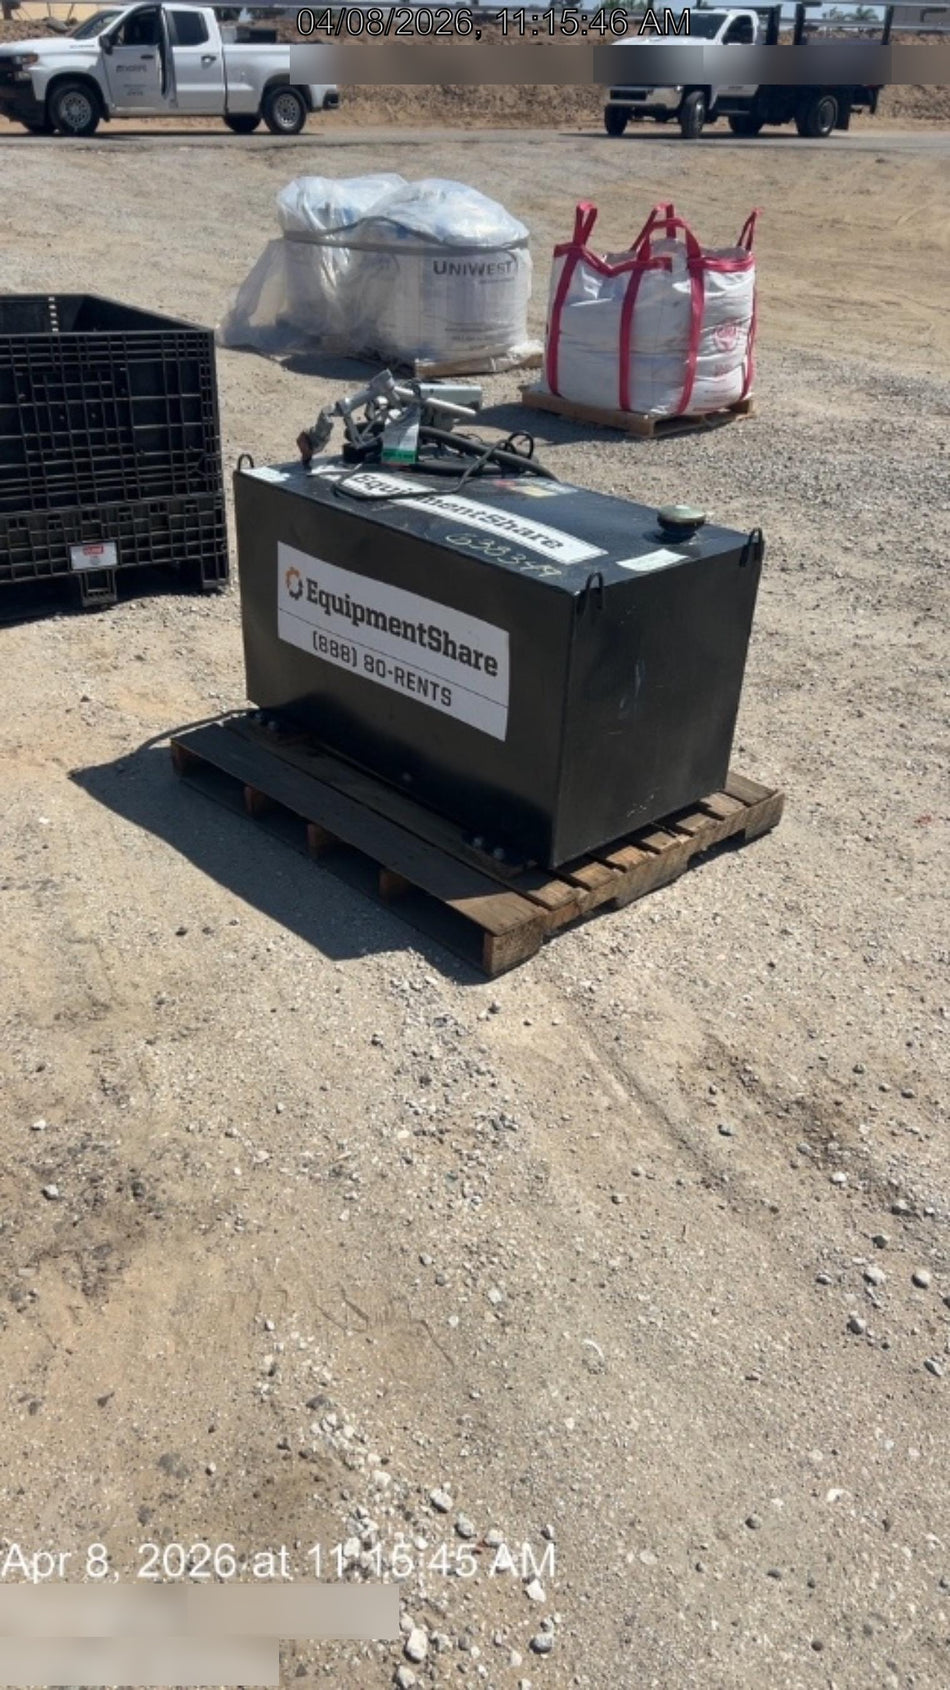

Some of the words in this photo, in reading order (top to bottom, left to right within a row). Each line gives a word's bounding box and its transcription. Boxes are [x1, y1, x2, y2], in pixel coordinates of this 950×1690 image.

[352, 473, 564, 551] EquimentShare
[305, 577, 499, 677] EquipmentShare
[312, 630, 358, 668] (888)
[363, 653, 453, 708] 80-RENTS
